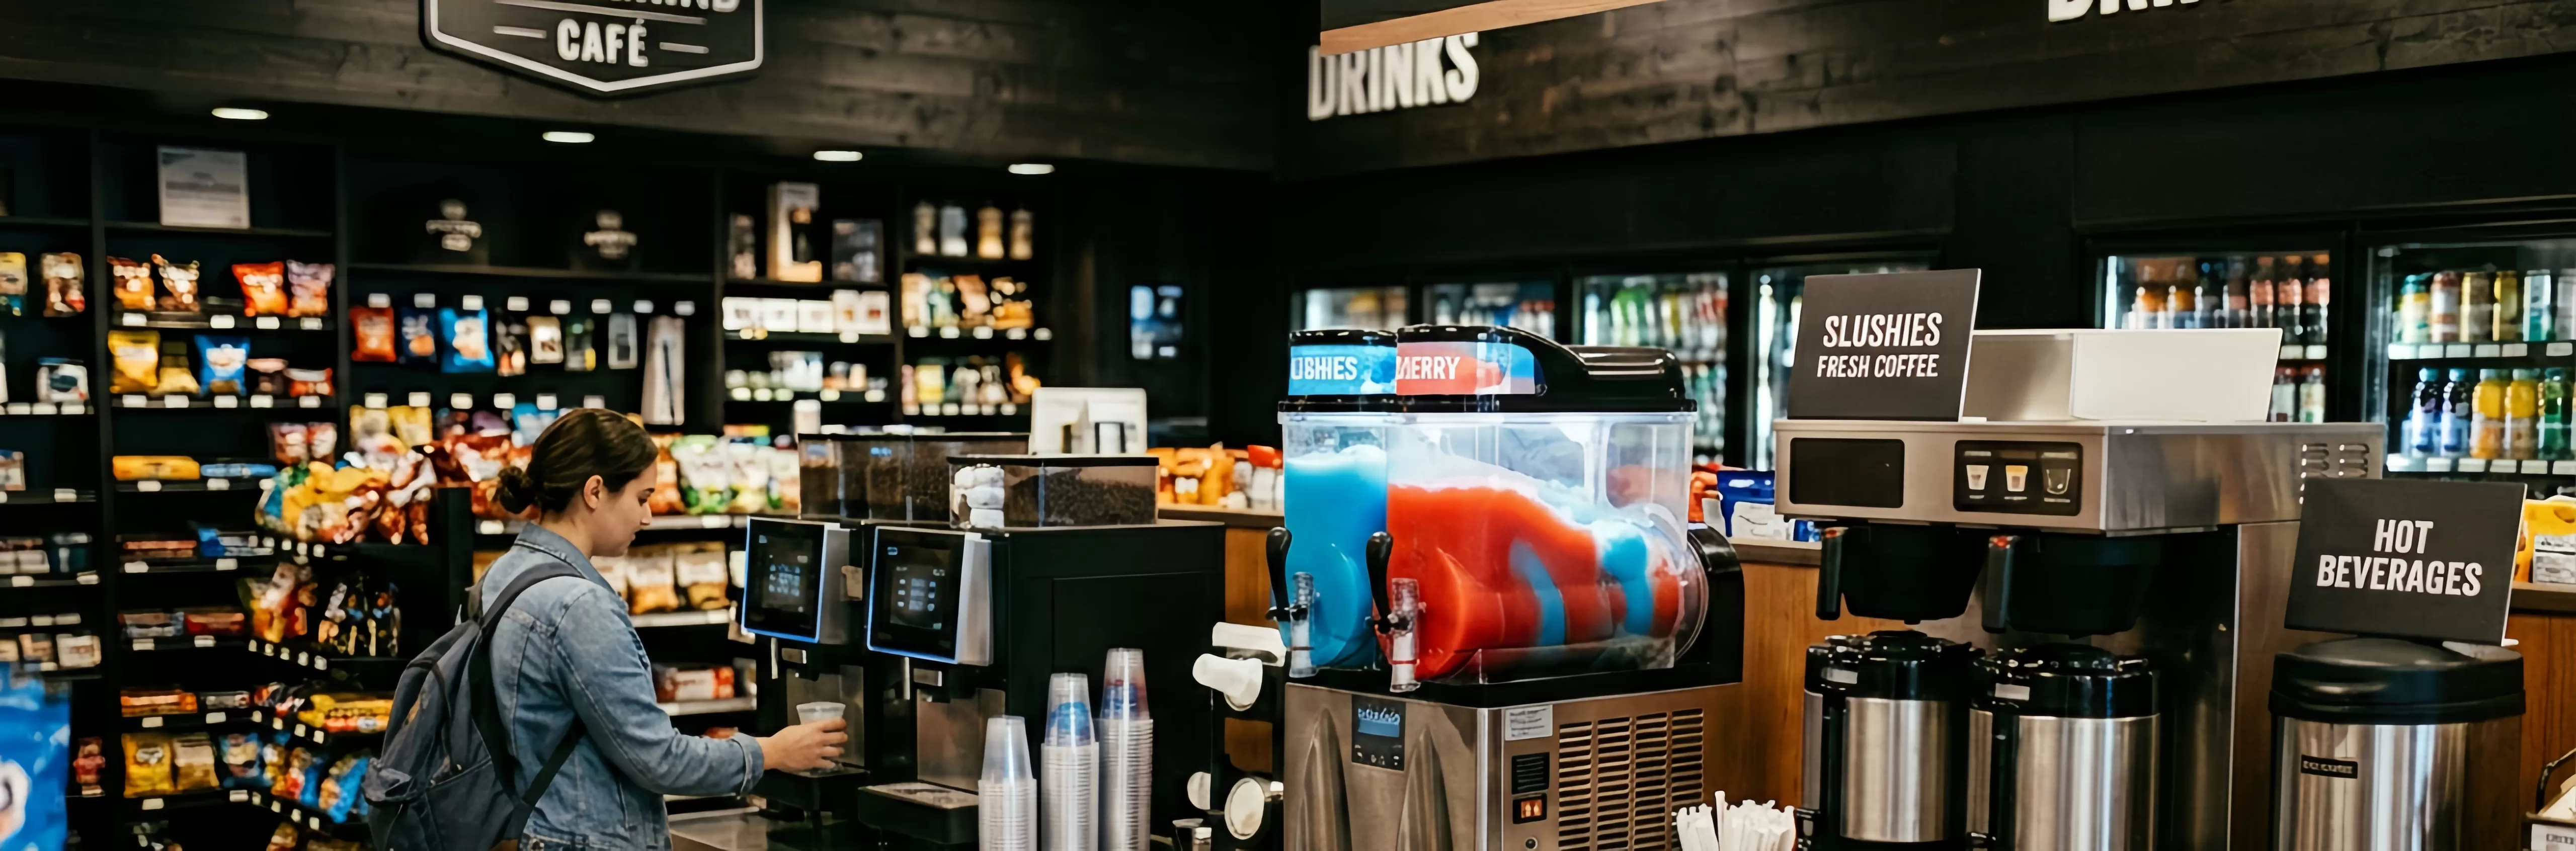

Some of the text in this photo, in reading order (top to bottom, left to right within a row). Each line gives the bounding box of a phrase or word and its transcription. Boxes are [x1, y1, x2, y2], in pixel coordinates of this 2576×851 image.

[557, 19, 649, 66] CAFÉ
[1308, 31, 1479, 121] DRINKS
[1823, 312, 1942, 348] SLUSHIES
[1817, 354, 1940, 377] FRESH COFFEE
[2374, 519, 2434, 554] HOT
[2316, 555, 2482, 597] BEVERAGES
